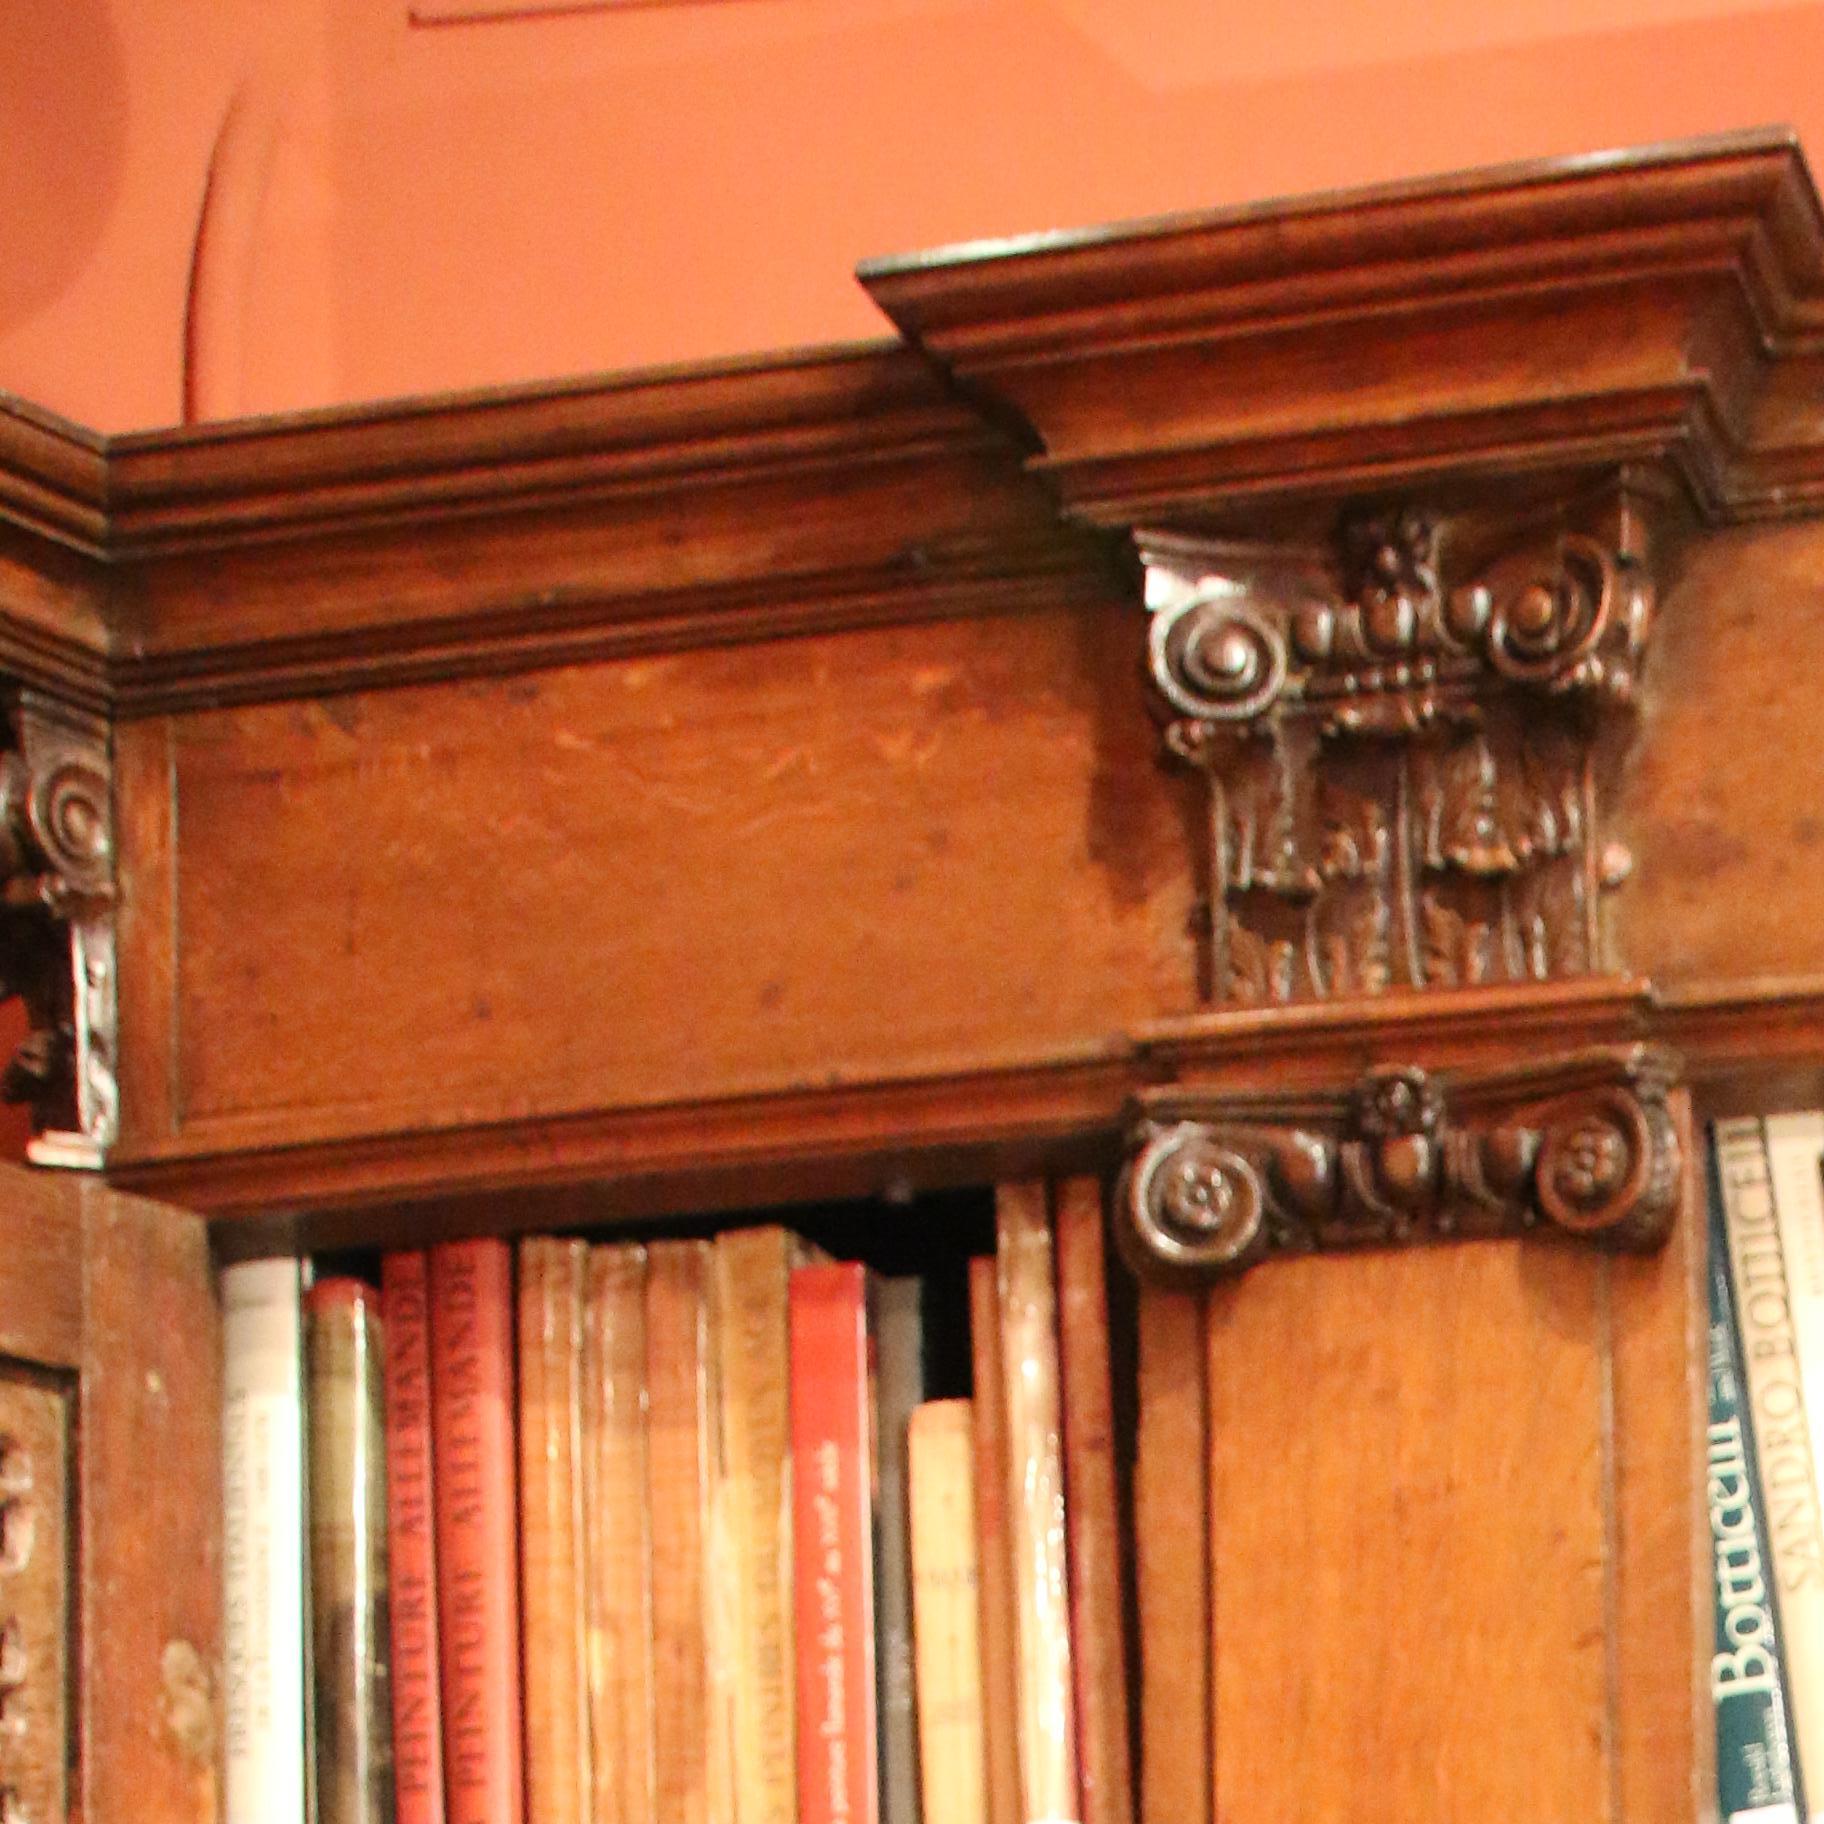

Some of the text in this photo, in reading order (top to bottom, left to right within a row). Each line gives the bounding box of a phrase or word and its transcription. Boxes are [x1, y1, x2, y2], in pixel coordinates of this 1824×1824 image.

[1723, 1127, 1794, 1362] BOTTICELLI
[392, 1271, 427, 1537] ALLEMANDE
[448, 1256, 483, 1529] ALLEMANDE
[1762, 1380, 1824, 1593] SANDRO
[1709, 1415, 1775, 1701] Botticelli
[396, 1574, 429, 1792] PEINTURE
[451, 1567, 485, 1789] PEINTURE
